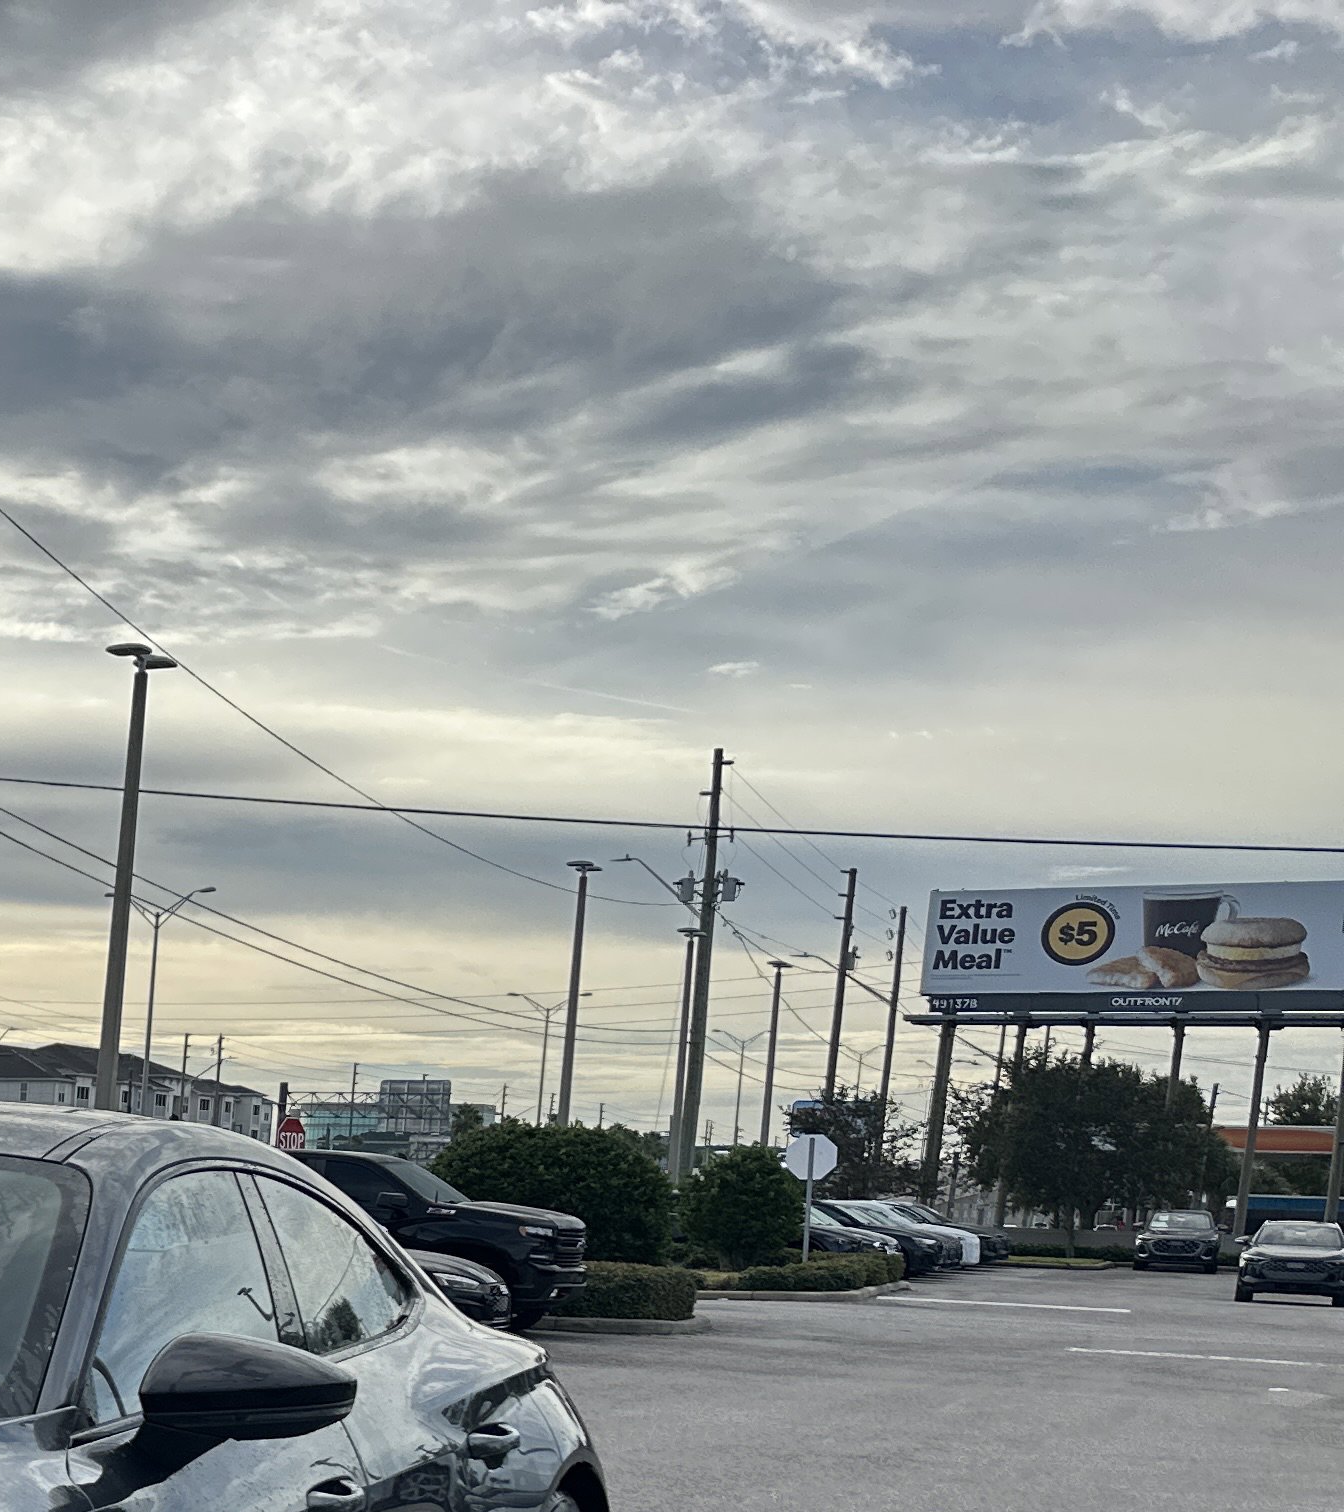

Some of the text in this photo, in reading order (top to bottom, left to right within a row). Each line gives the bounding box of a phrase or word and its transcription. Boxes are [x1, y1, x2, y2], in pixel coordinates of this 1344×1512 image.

[939, 899, 1014, 920] Extra
[936, 923, 1016, 945] Value
[1058, 921, 1098, 946] $5
[279, 1131, 305, 1150] STOP
